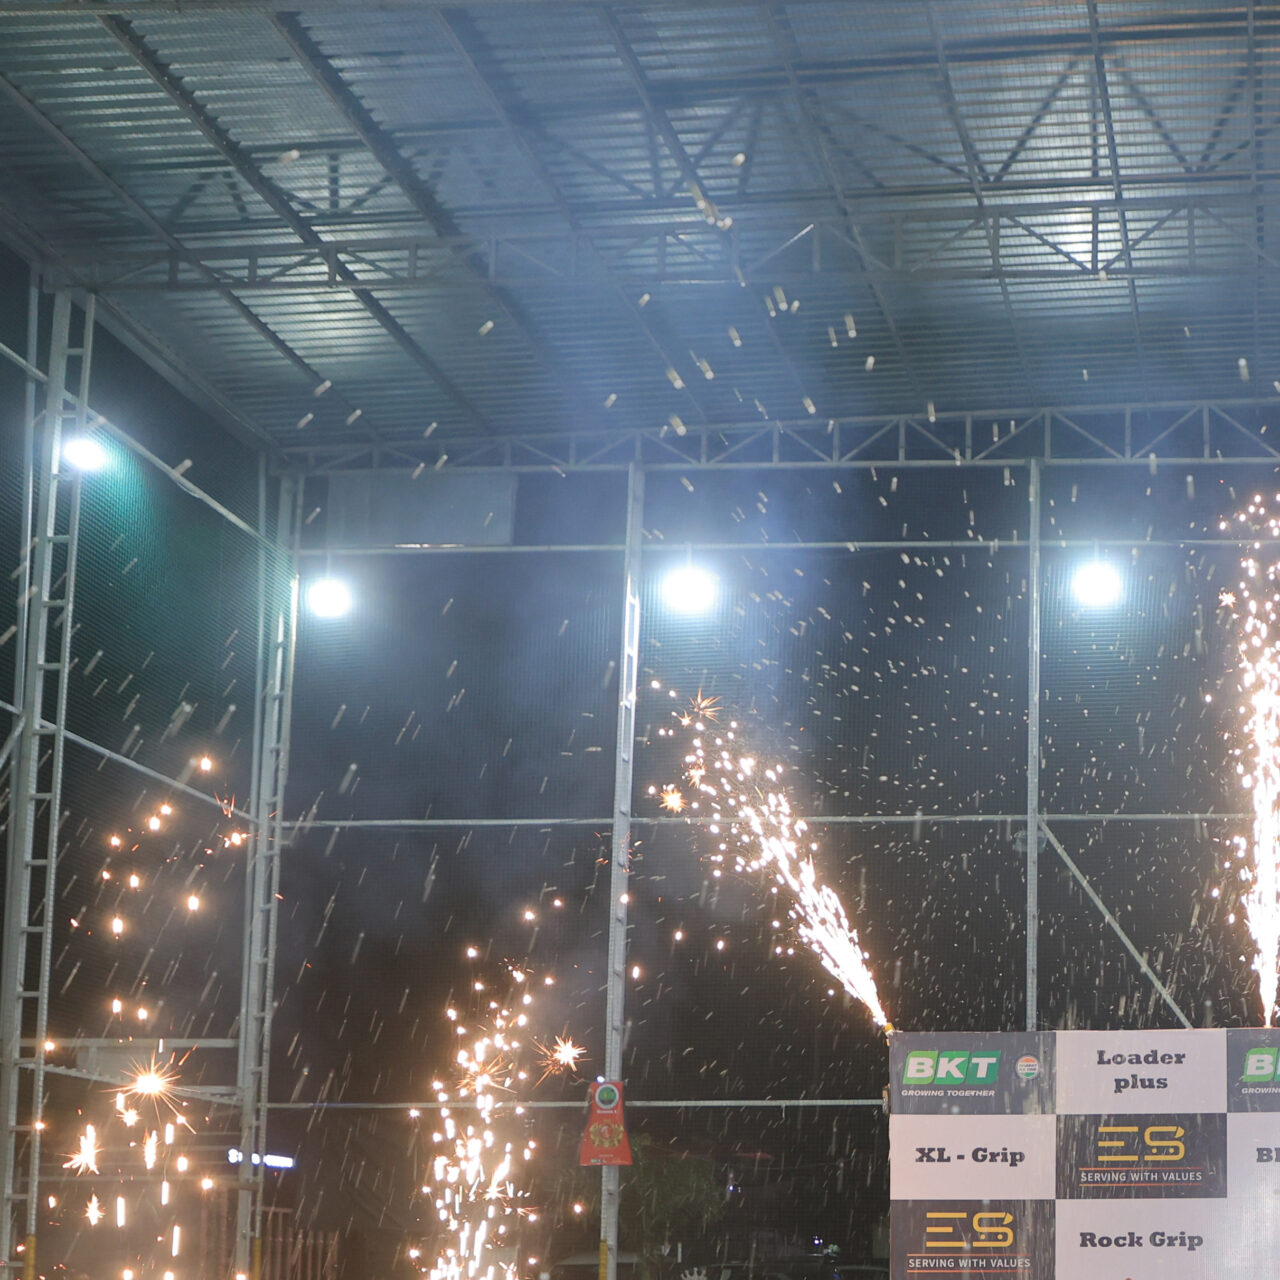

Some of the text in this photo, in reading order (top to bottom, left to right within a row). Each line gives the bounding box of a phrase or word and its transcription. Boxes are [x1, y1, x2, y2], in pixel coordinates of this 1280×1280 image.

[1097, 1049, 1186, 1066] Loader
[906, 1056, 997, 1080] BKT
[902, 1088, 995, 1097] GROWING TOGETHER
[1114, 1074, 1168, 1093] plus
[1097, 1125, 1186, 1161] ES
[915, 1147, 951, 1163] XL
[972, 1147, 1025, 1167] Grip
[1081, 1171, 1202, 1182] SERVING WITH VALUES
[926, 1211, 1013, 1248] ES
[1079, 1232, 1204, 1251] Rock Grip
[908, 1258, 1031, 1269] SERVING WITH VALUES
